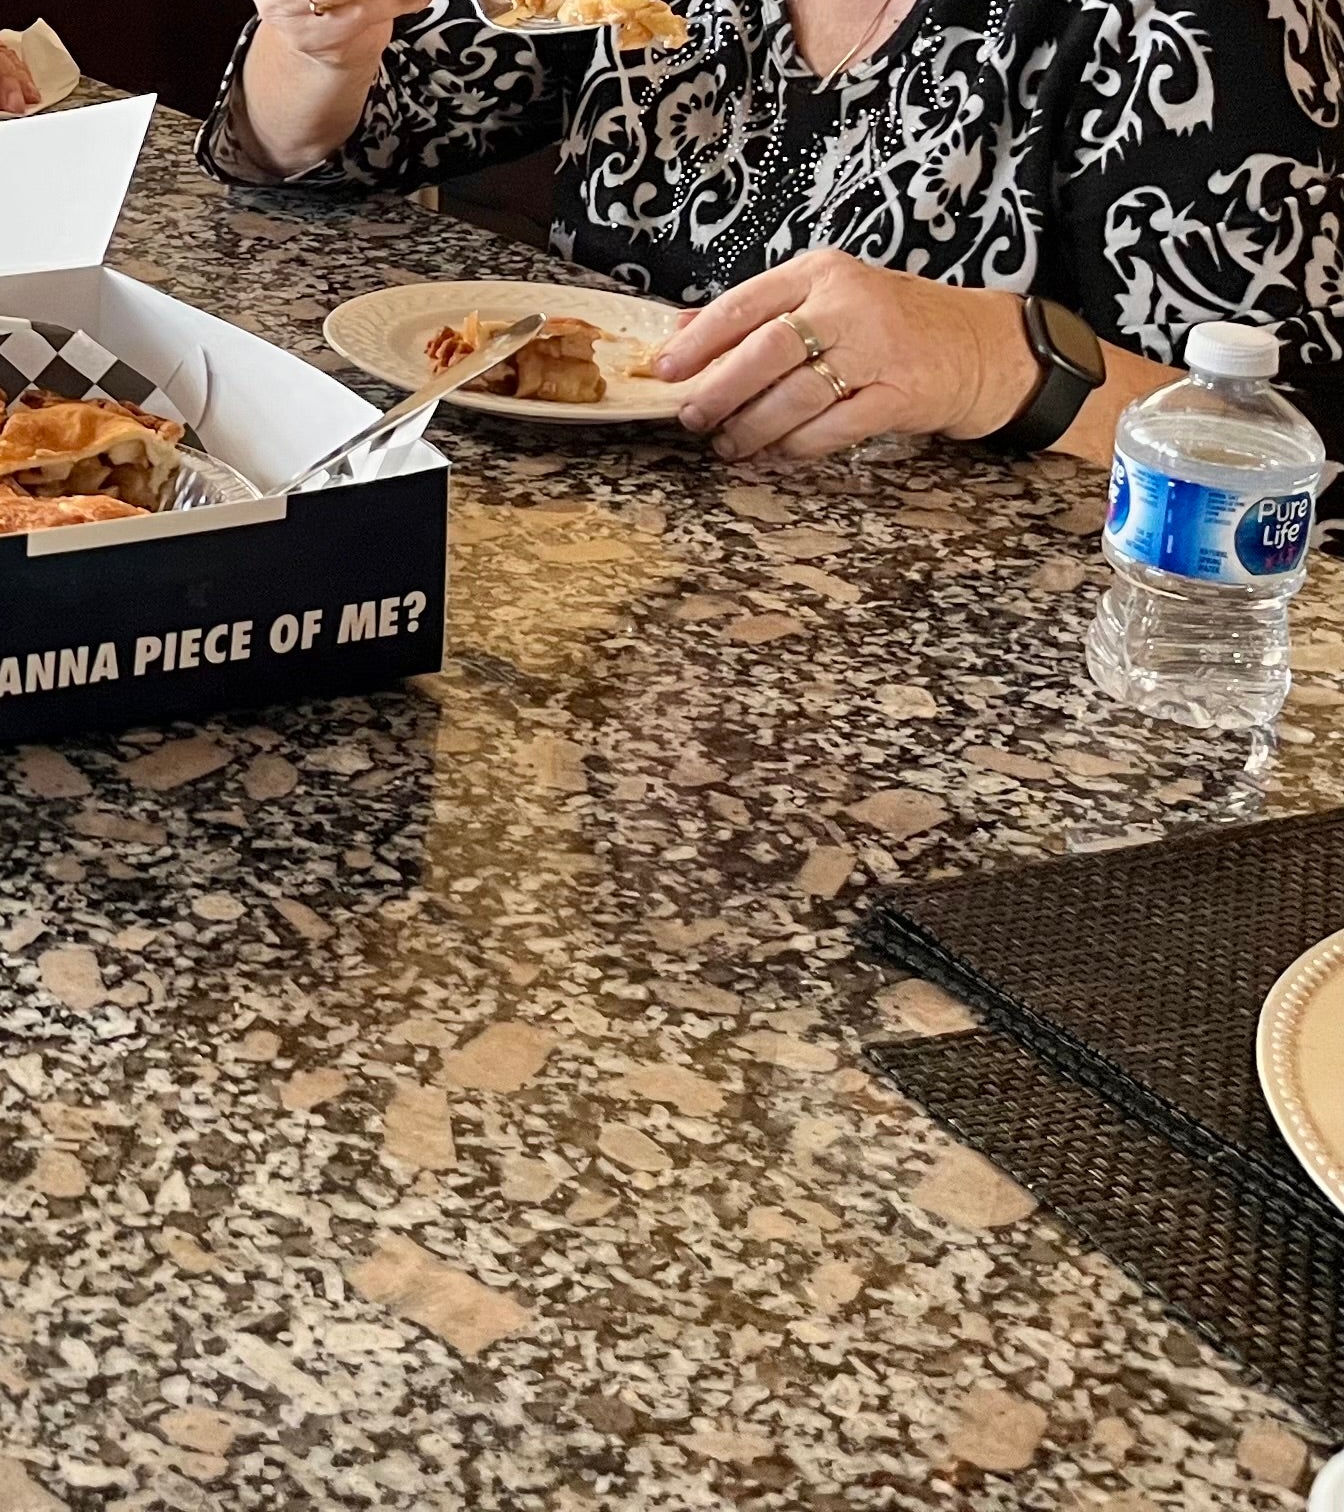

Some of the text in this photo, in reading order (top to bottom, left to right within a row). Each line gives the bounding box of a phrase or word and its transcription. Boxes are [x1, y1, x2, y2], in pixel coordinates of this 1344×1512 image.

[1257, 498, 1308, 523] Pure
[1263, 520, 1300, 550] Life
[134, 619, 253, 676] PIECE
[269, 608, 323, 654] OF
[337, 590, 427, 644] ME?
